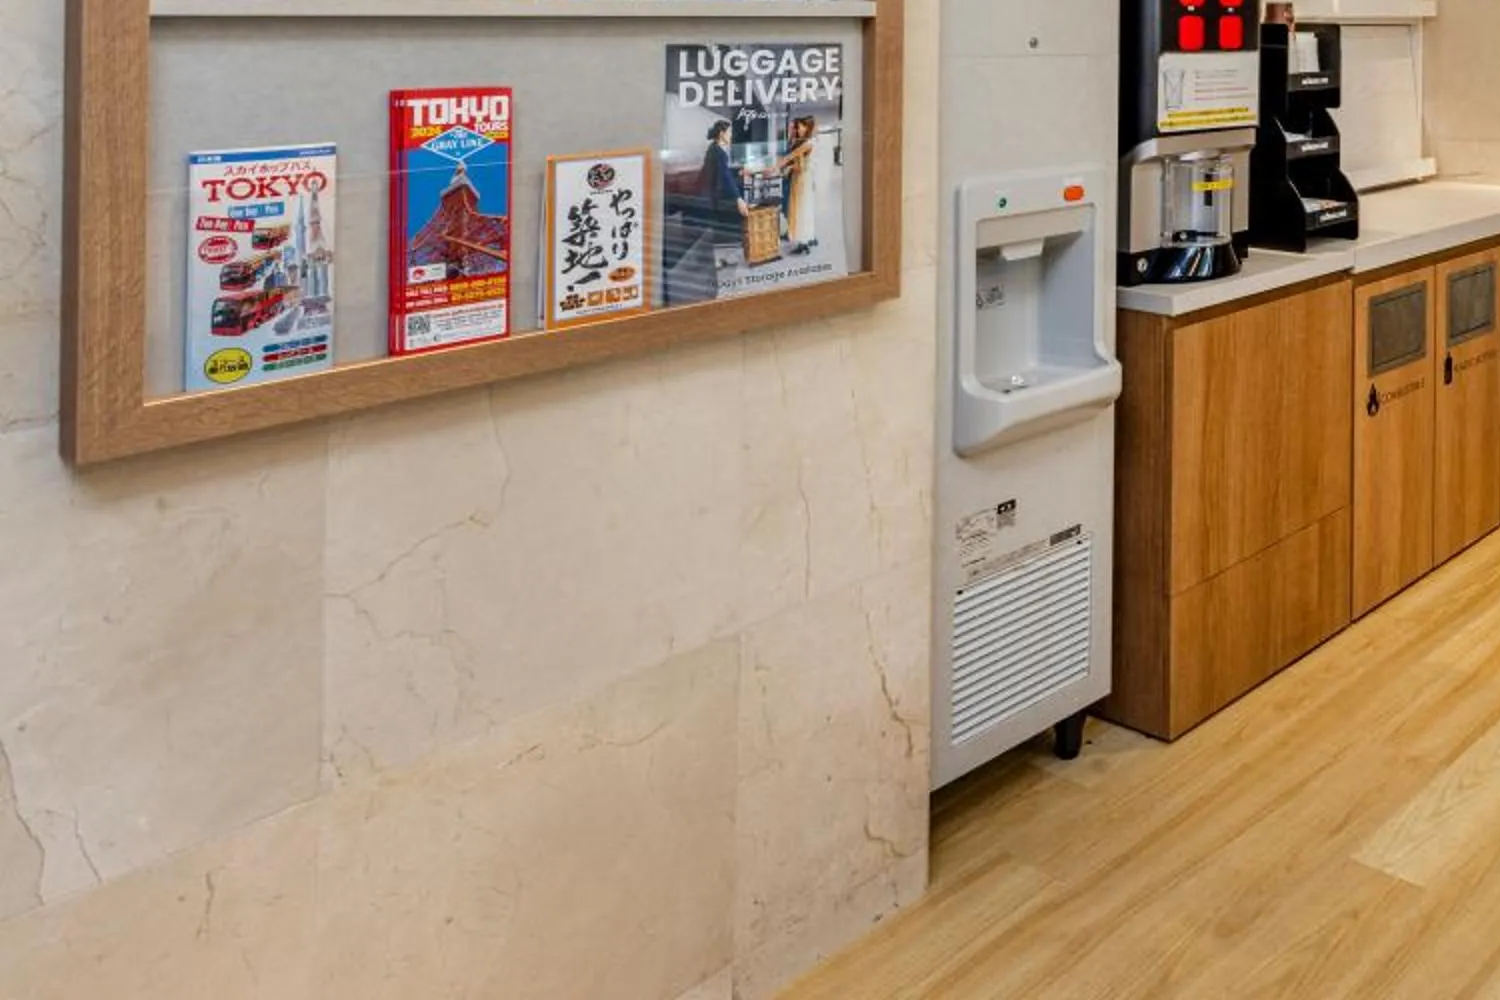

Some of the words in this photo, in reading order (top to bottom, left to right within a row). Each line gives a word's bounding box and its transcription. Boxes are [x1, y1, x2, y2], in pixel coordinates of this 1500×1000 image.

[679, 46, 840, 78] LUGGAGE
[679, 76, 841, 108] DELIVERY
[406, 95, 509, 127] TOKYO
[201, 171, 327, 203] TOKYO
